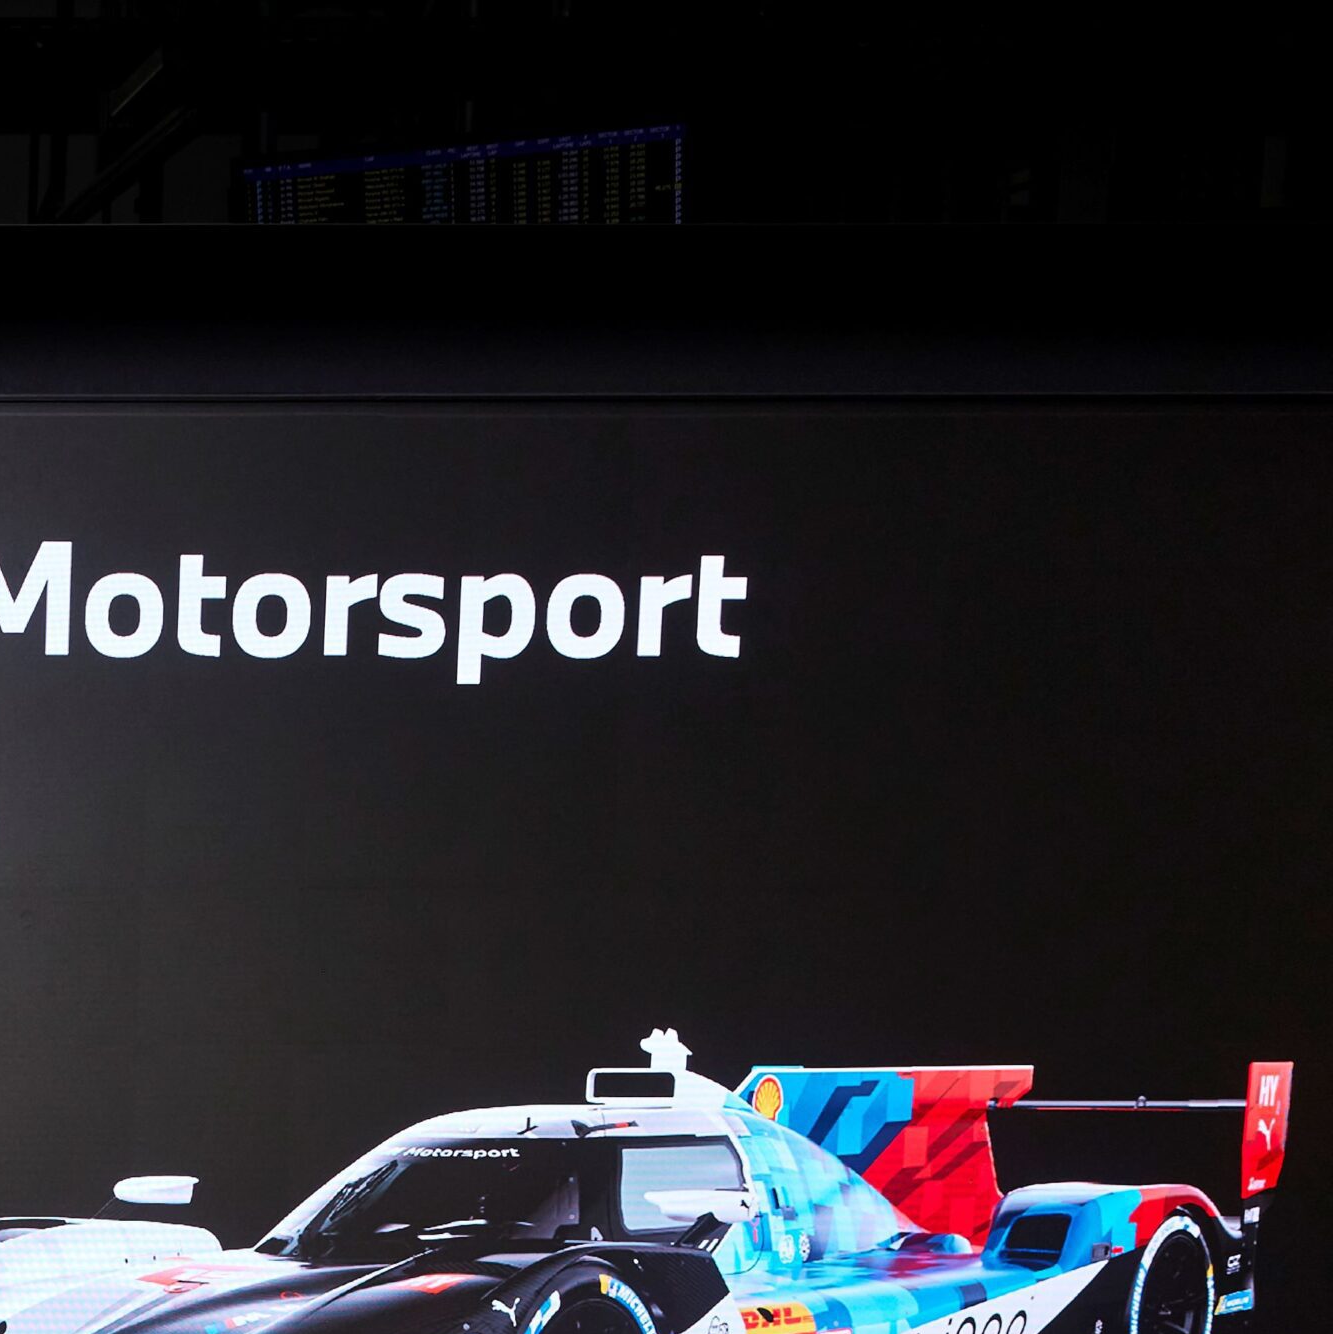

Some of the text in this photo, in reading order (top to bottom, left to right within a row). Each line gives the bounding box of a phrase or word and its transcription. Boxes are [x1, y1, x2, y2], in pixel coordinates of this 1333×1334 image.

[1258, 1075, 1280, 1107] HY
[403, 1147, 520, 1160] Motorsport
[740, 1307, 802, 1330] DHL
